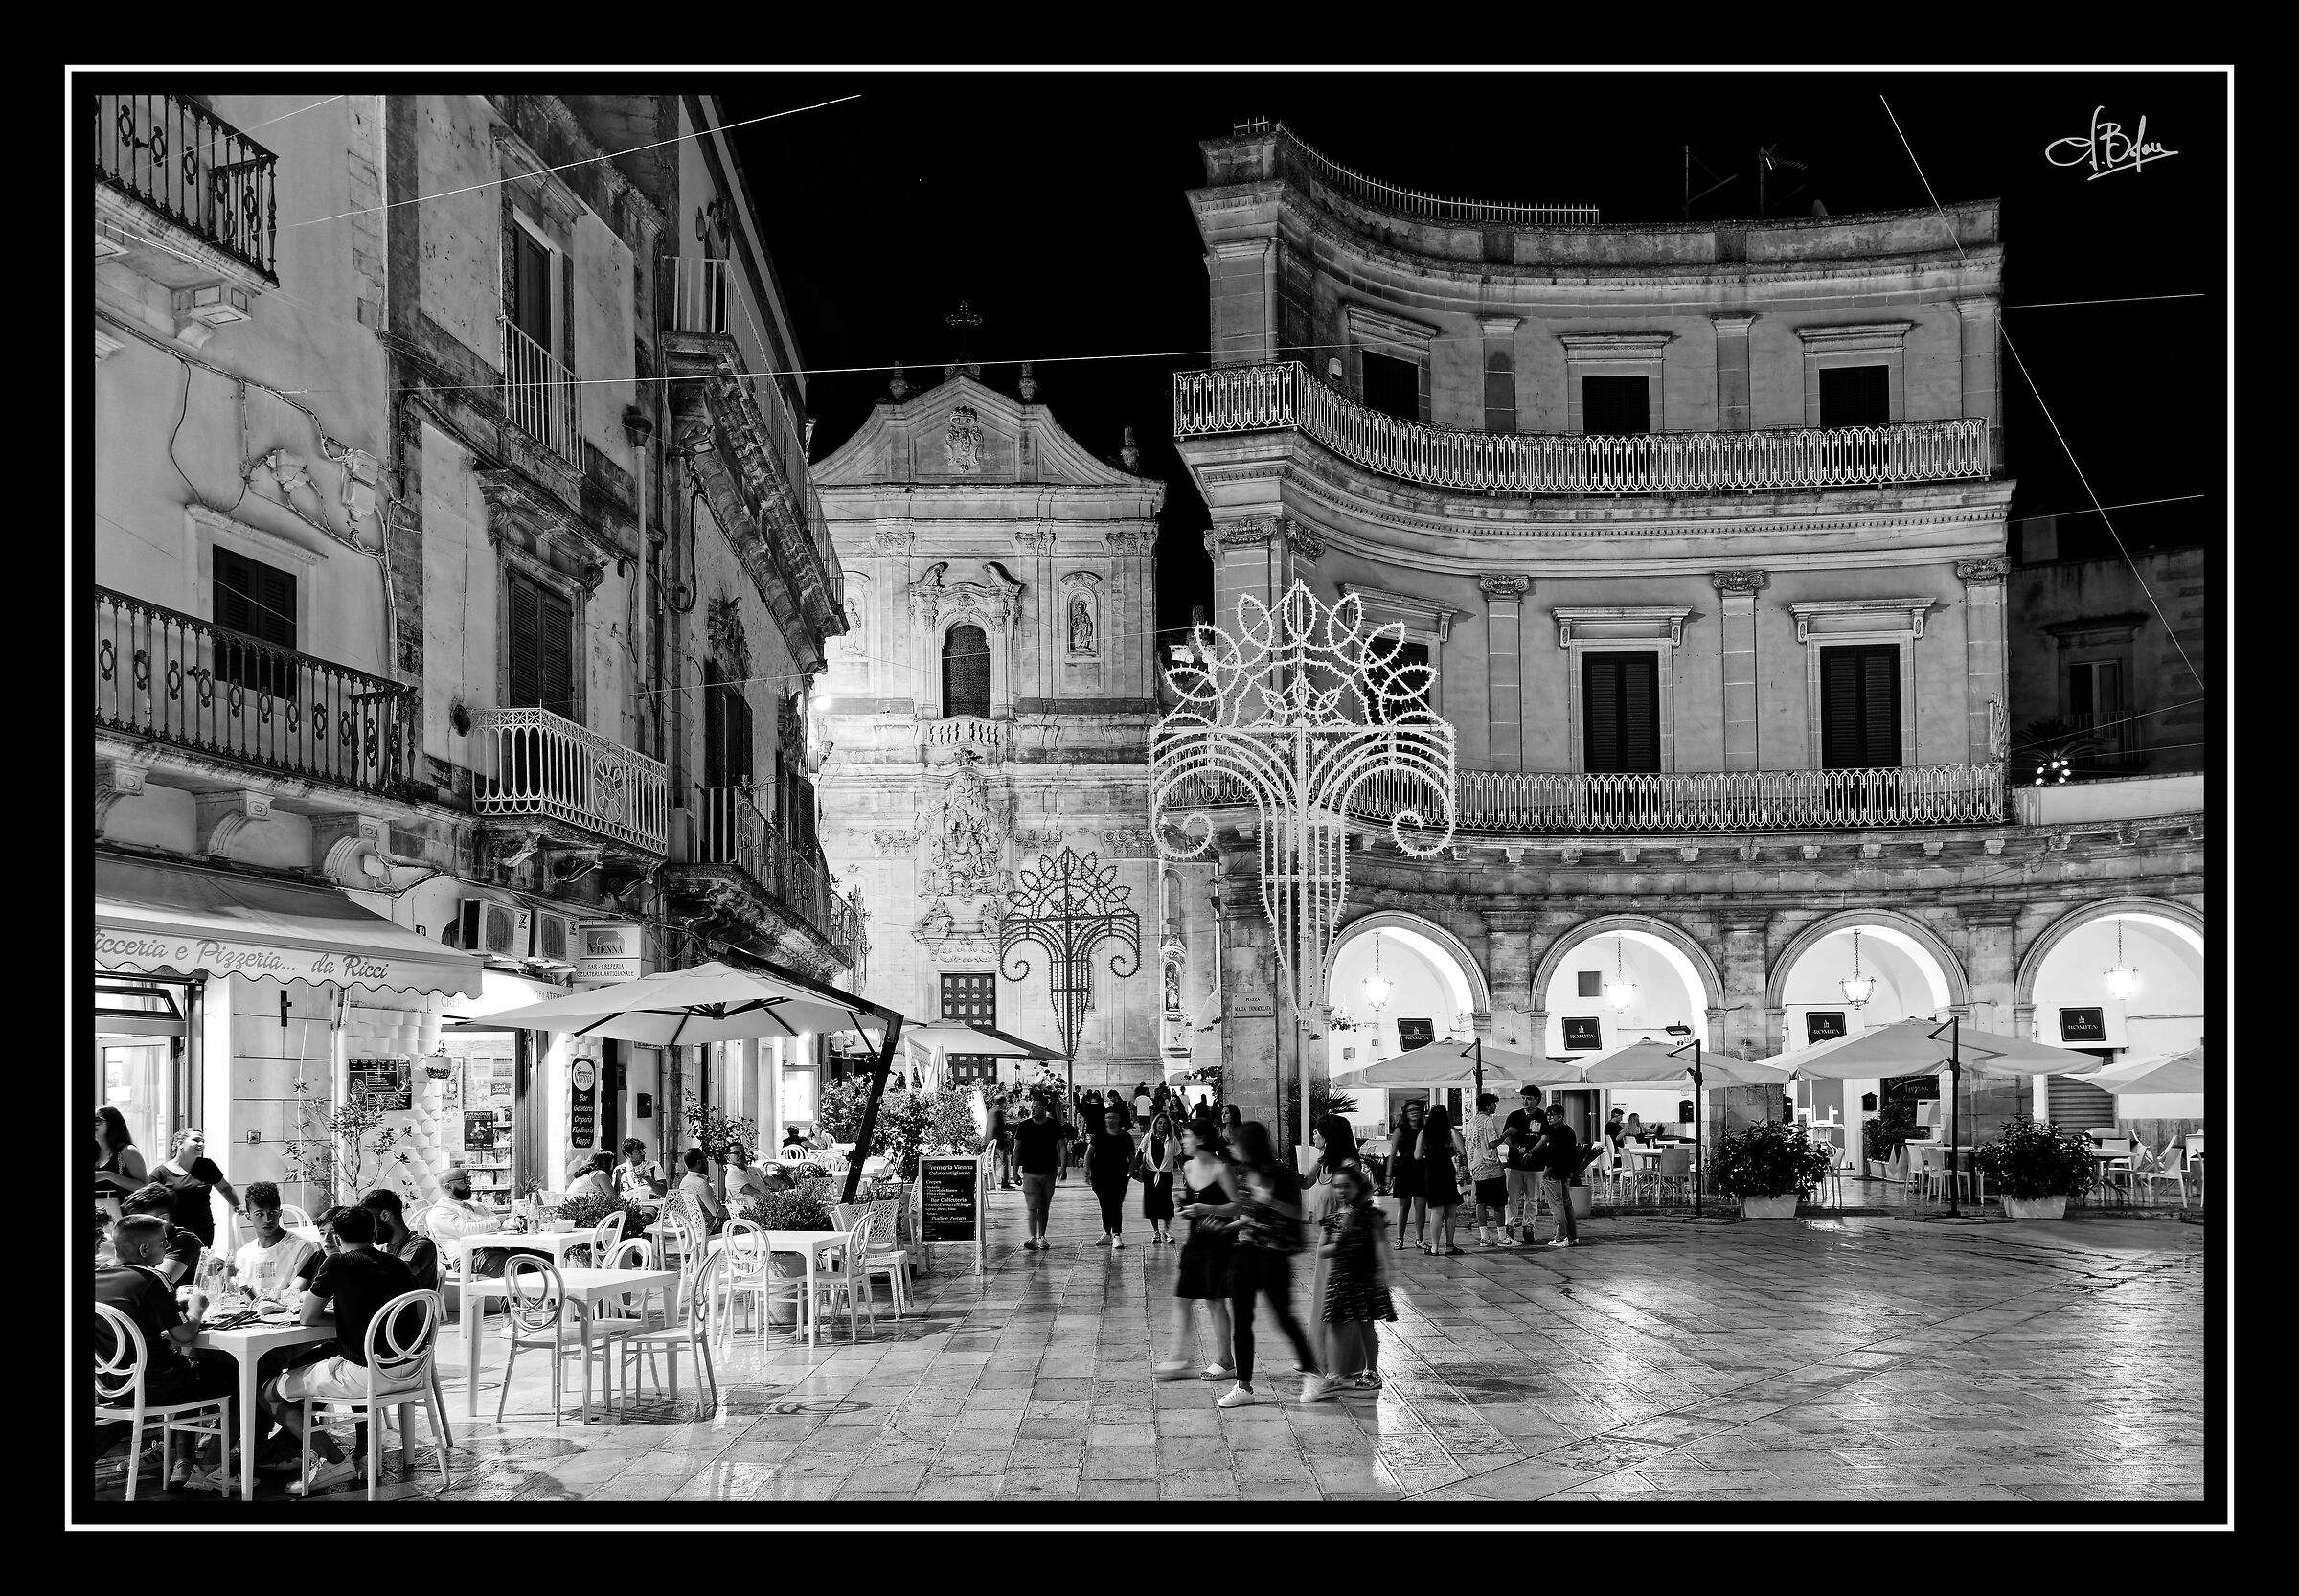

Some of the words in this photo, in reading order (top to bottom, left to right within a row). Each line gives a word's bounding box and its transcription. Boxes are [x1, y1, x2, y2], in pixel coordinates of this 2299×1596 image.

[95, 926, 169, 956] icceria
[175, 946, 189, 960] e
[311, 952, 336, 973] da
[342, 954, 389, 980] Ricci
[579, 1093, 589, 1102] Bar
